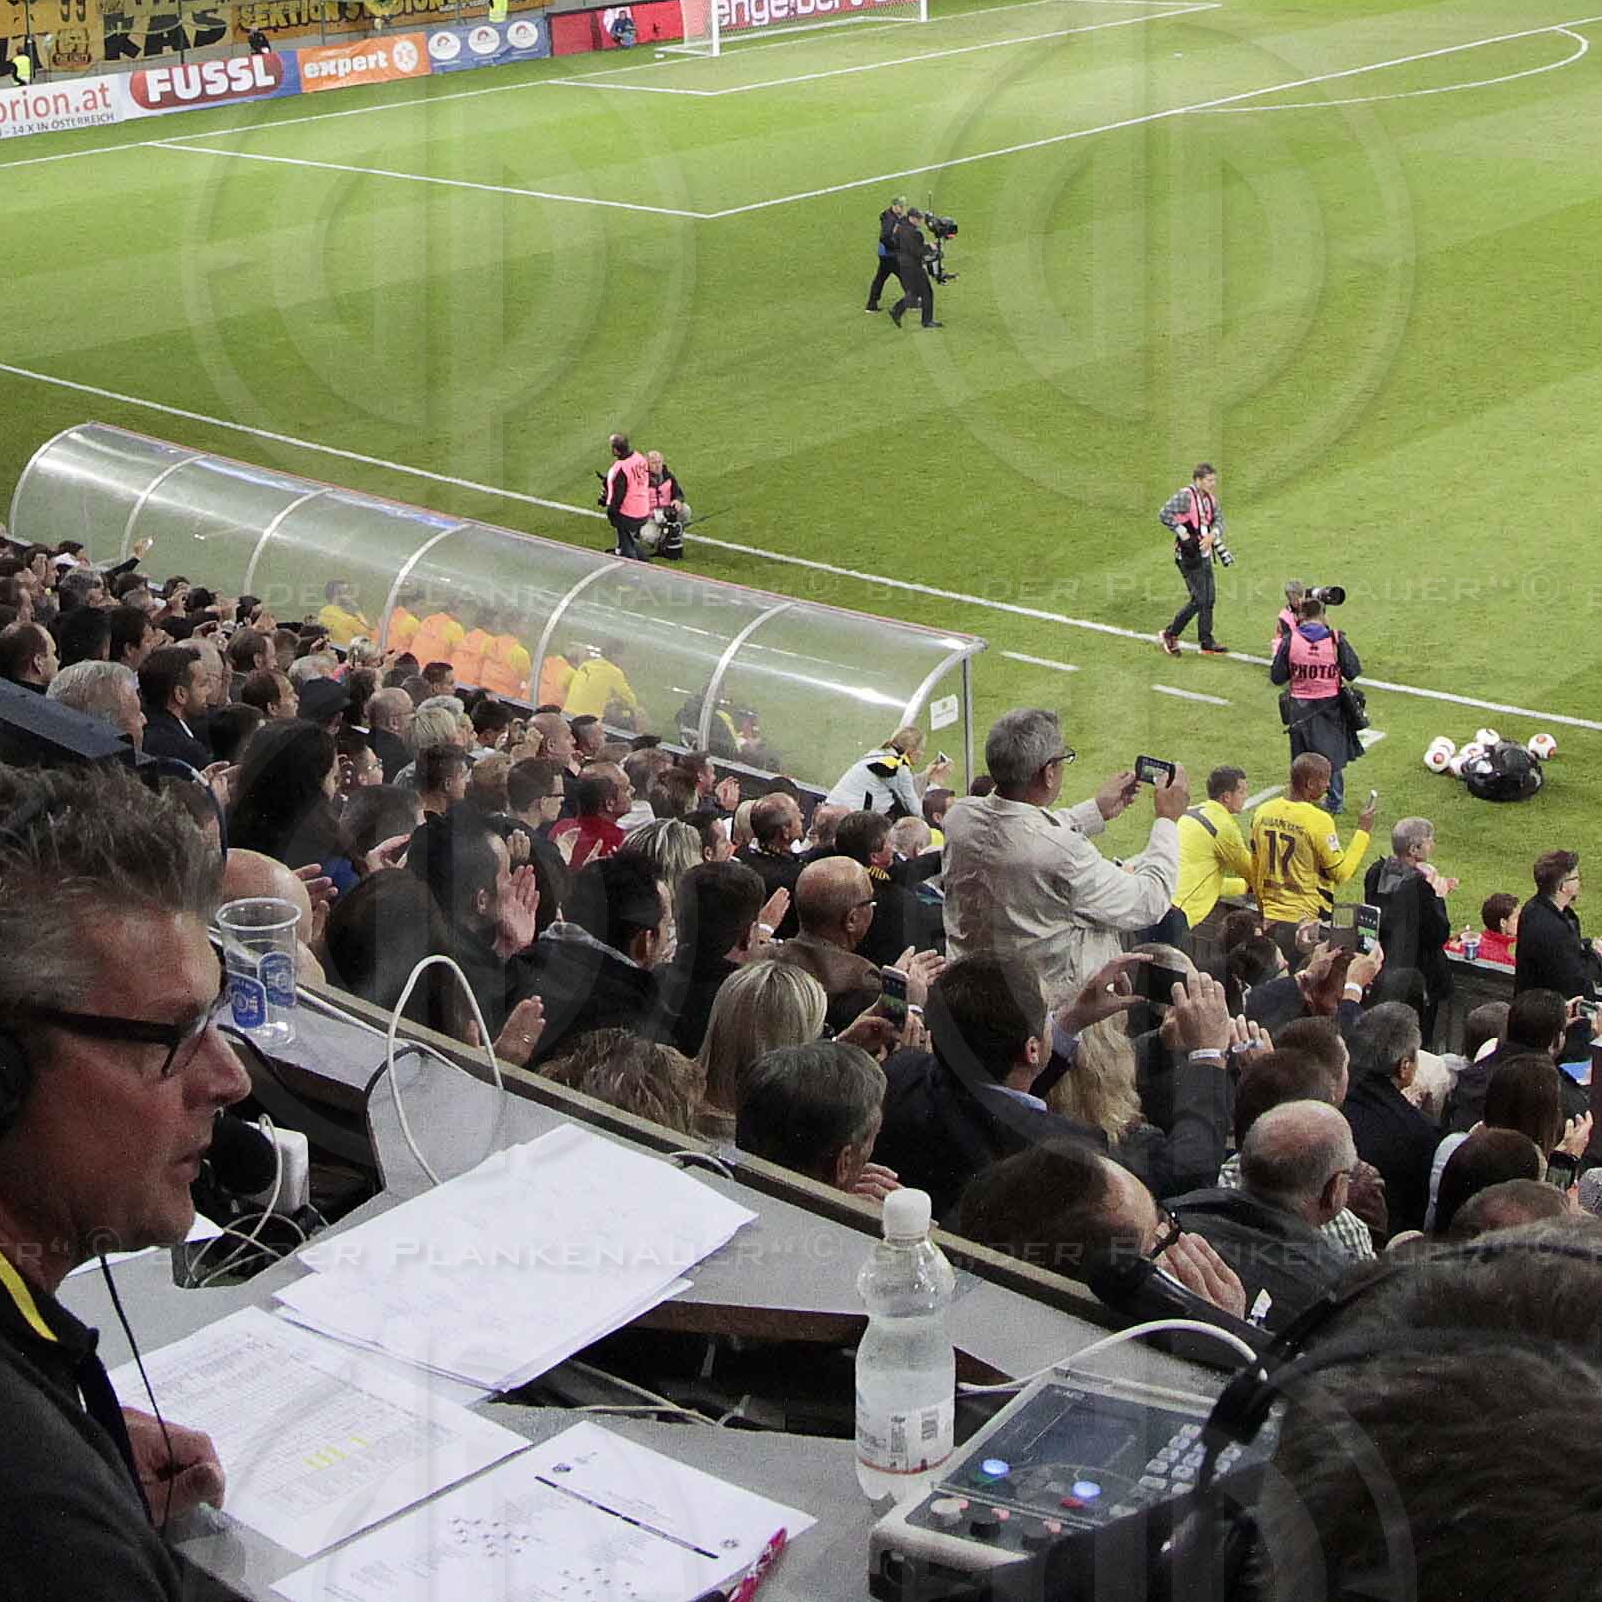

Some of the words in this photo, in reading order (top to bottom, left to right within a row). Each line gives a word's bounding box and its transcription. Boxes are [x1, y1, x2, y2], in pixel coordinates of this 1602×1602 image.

[145, 53, 276, 103] FUSSL
[303, 50, 389, 80] expert
[1291, 661, 1338, 680] PHOTO
[1264, 830, 1295, 880] 17
